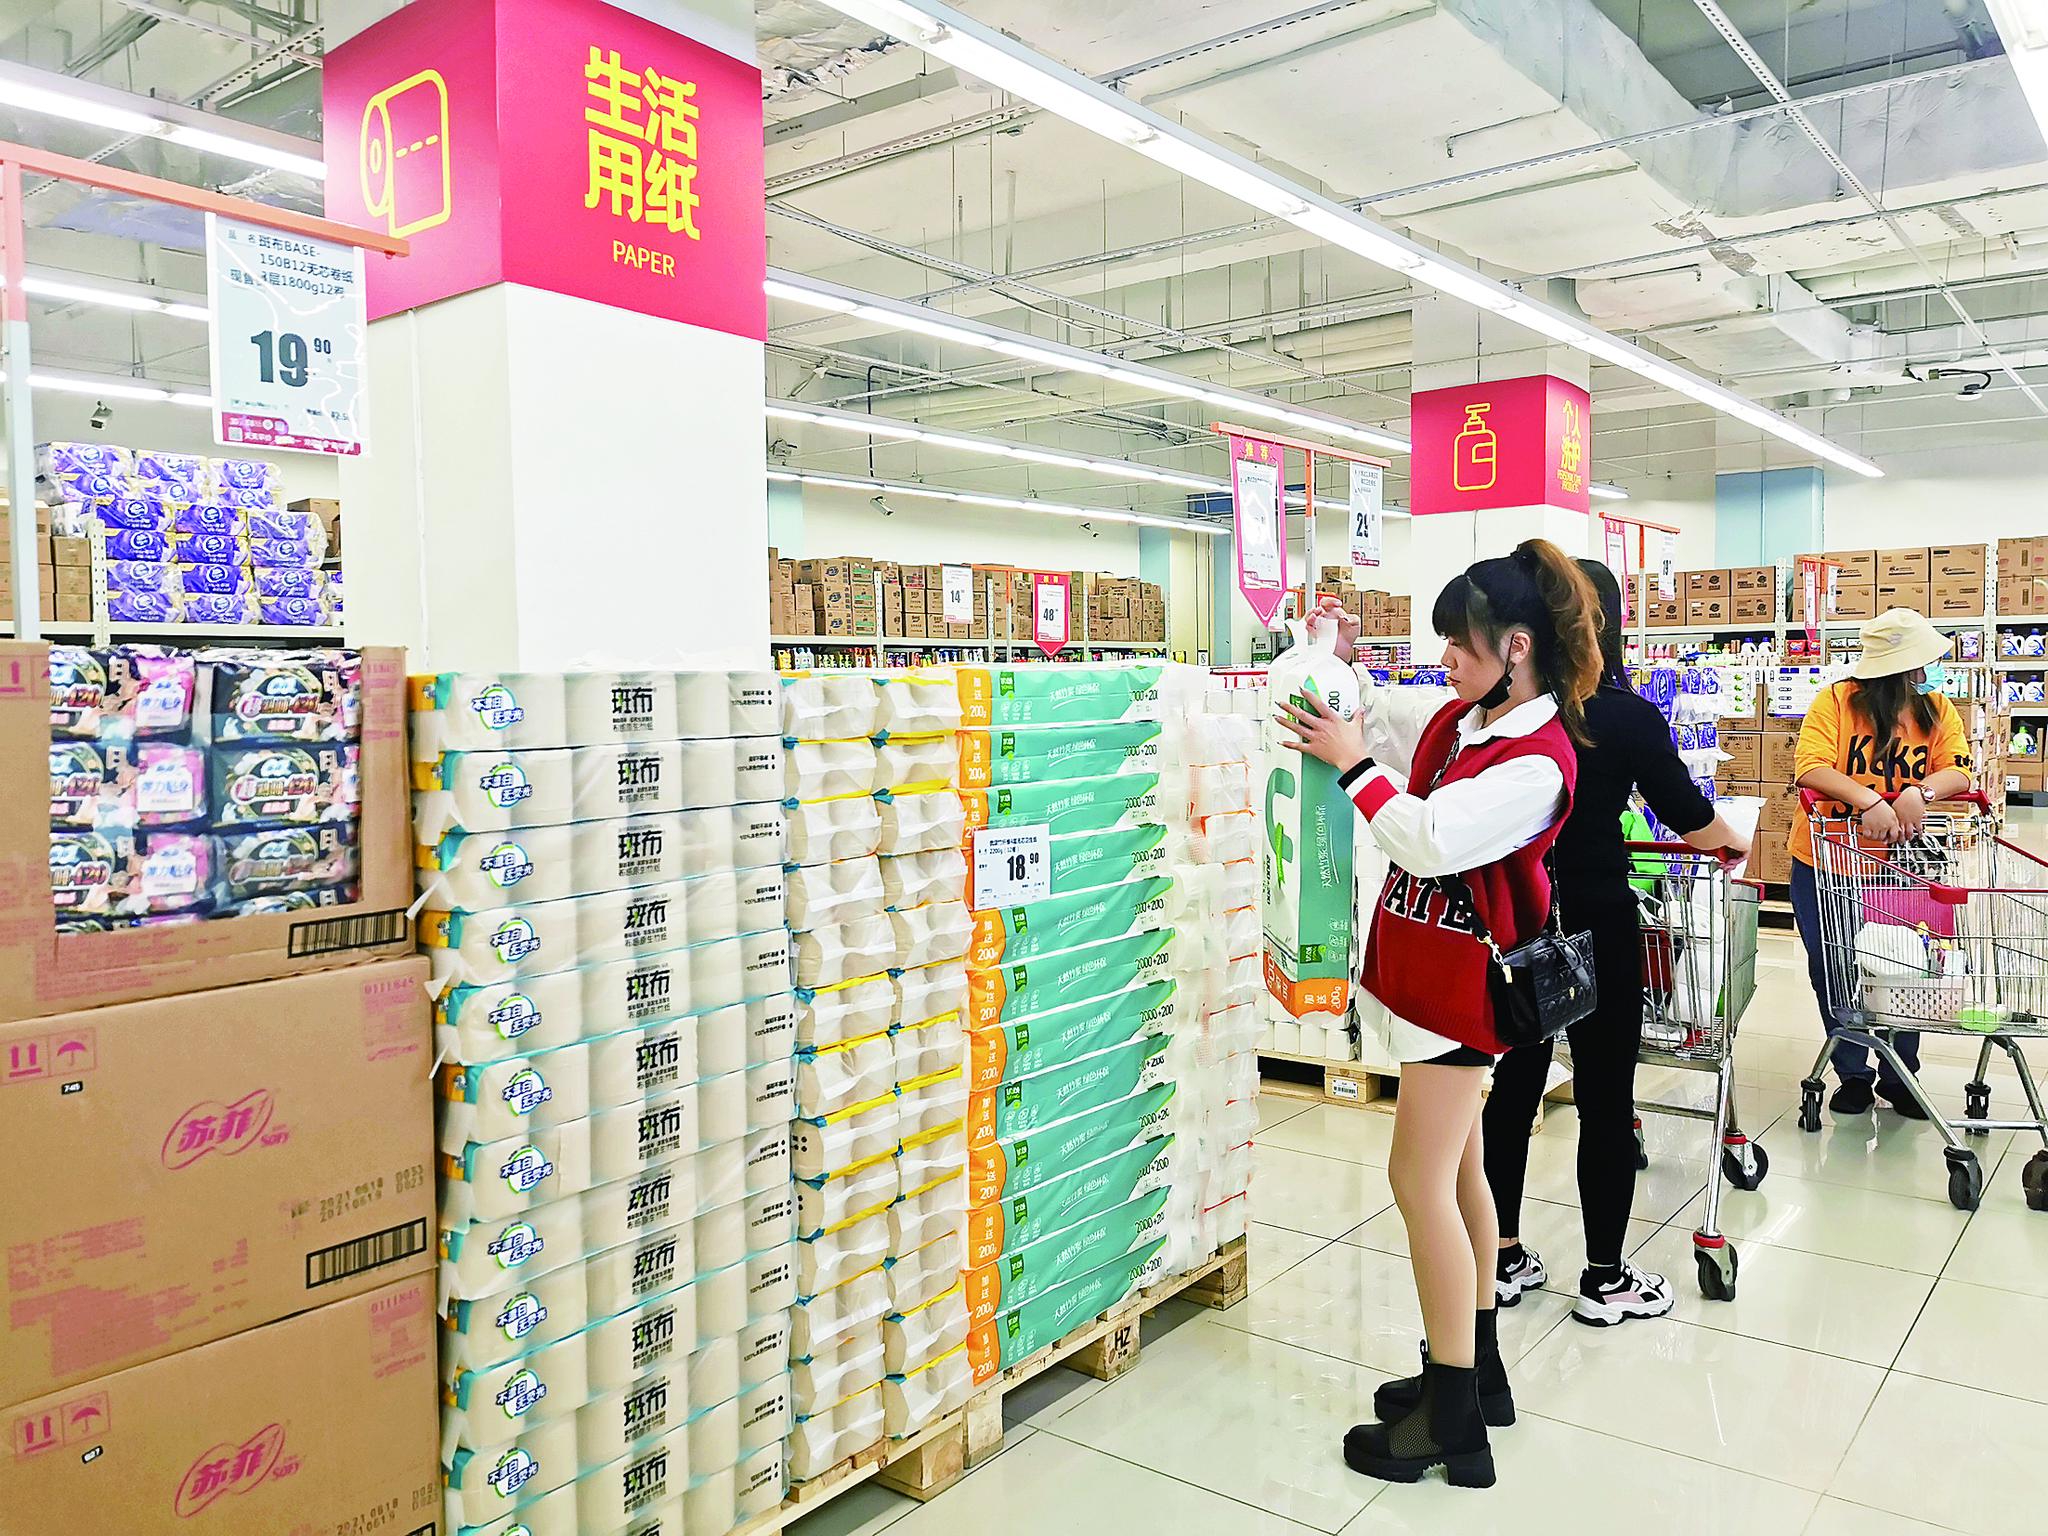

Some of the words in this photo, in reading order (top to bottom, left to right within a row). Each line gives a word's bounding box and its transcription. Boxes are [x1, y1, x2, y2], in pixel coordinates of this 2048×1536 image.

[584, 45, 699, 160] 生活
[584, 128, 701, 241] 用纸
[612, 239, 676, 278] PAPER
[250, 330, 308, 387] 19
[314, 338, 331, 354] 90
[1562, 399, 1582, 440] 个人
[950, 590, 961, 603] 14
[1043, 608, 1054, 621] 48
[969, 706, 986, 718] 200g
[1124, 744, 1157, 757] 2000+200
[968, 767, 986, 780] 200g
[1030, 852, 1039, 864] 90
[1131, 847, 1166, 864] 2000+200
[1383, 866, 1473, 935] ATE
[1135, 952, 1169, 970] 2000+200
[1140, 1004, 1174, 1023] 2000+200
[1115, 1325, 1131, 1351] HZ
